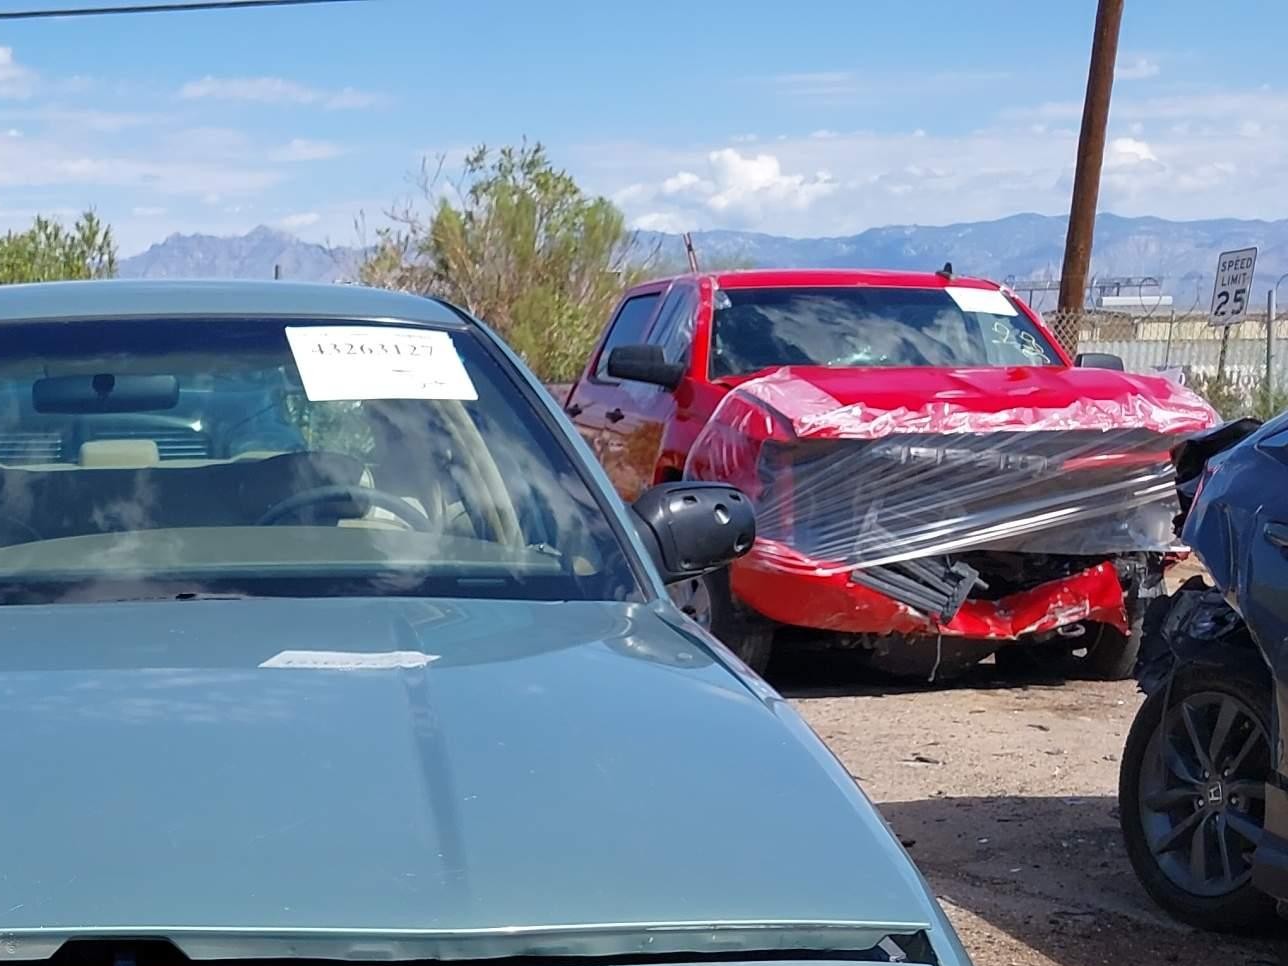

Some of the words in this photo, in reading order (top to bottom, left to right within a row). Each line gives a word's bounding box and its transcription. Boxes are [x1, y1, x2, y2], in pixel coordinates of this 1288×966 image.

[1220, 257, 1253, 272] SPEED
[1221, 273, 1248, 287] LIMIT
[1214, 289, 1246, 316] 25
